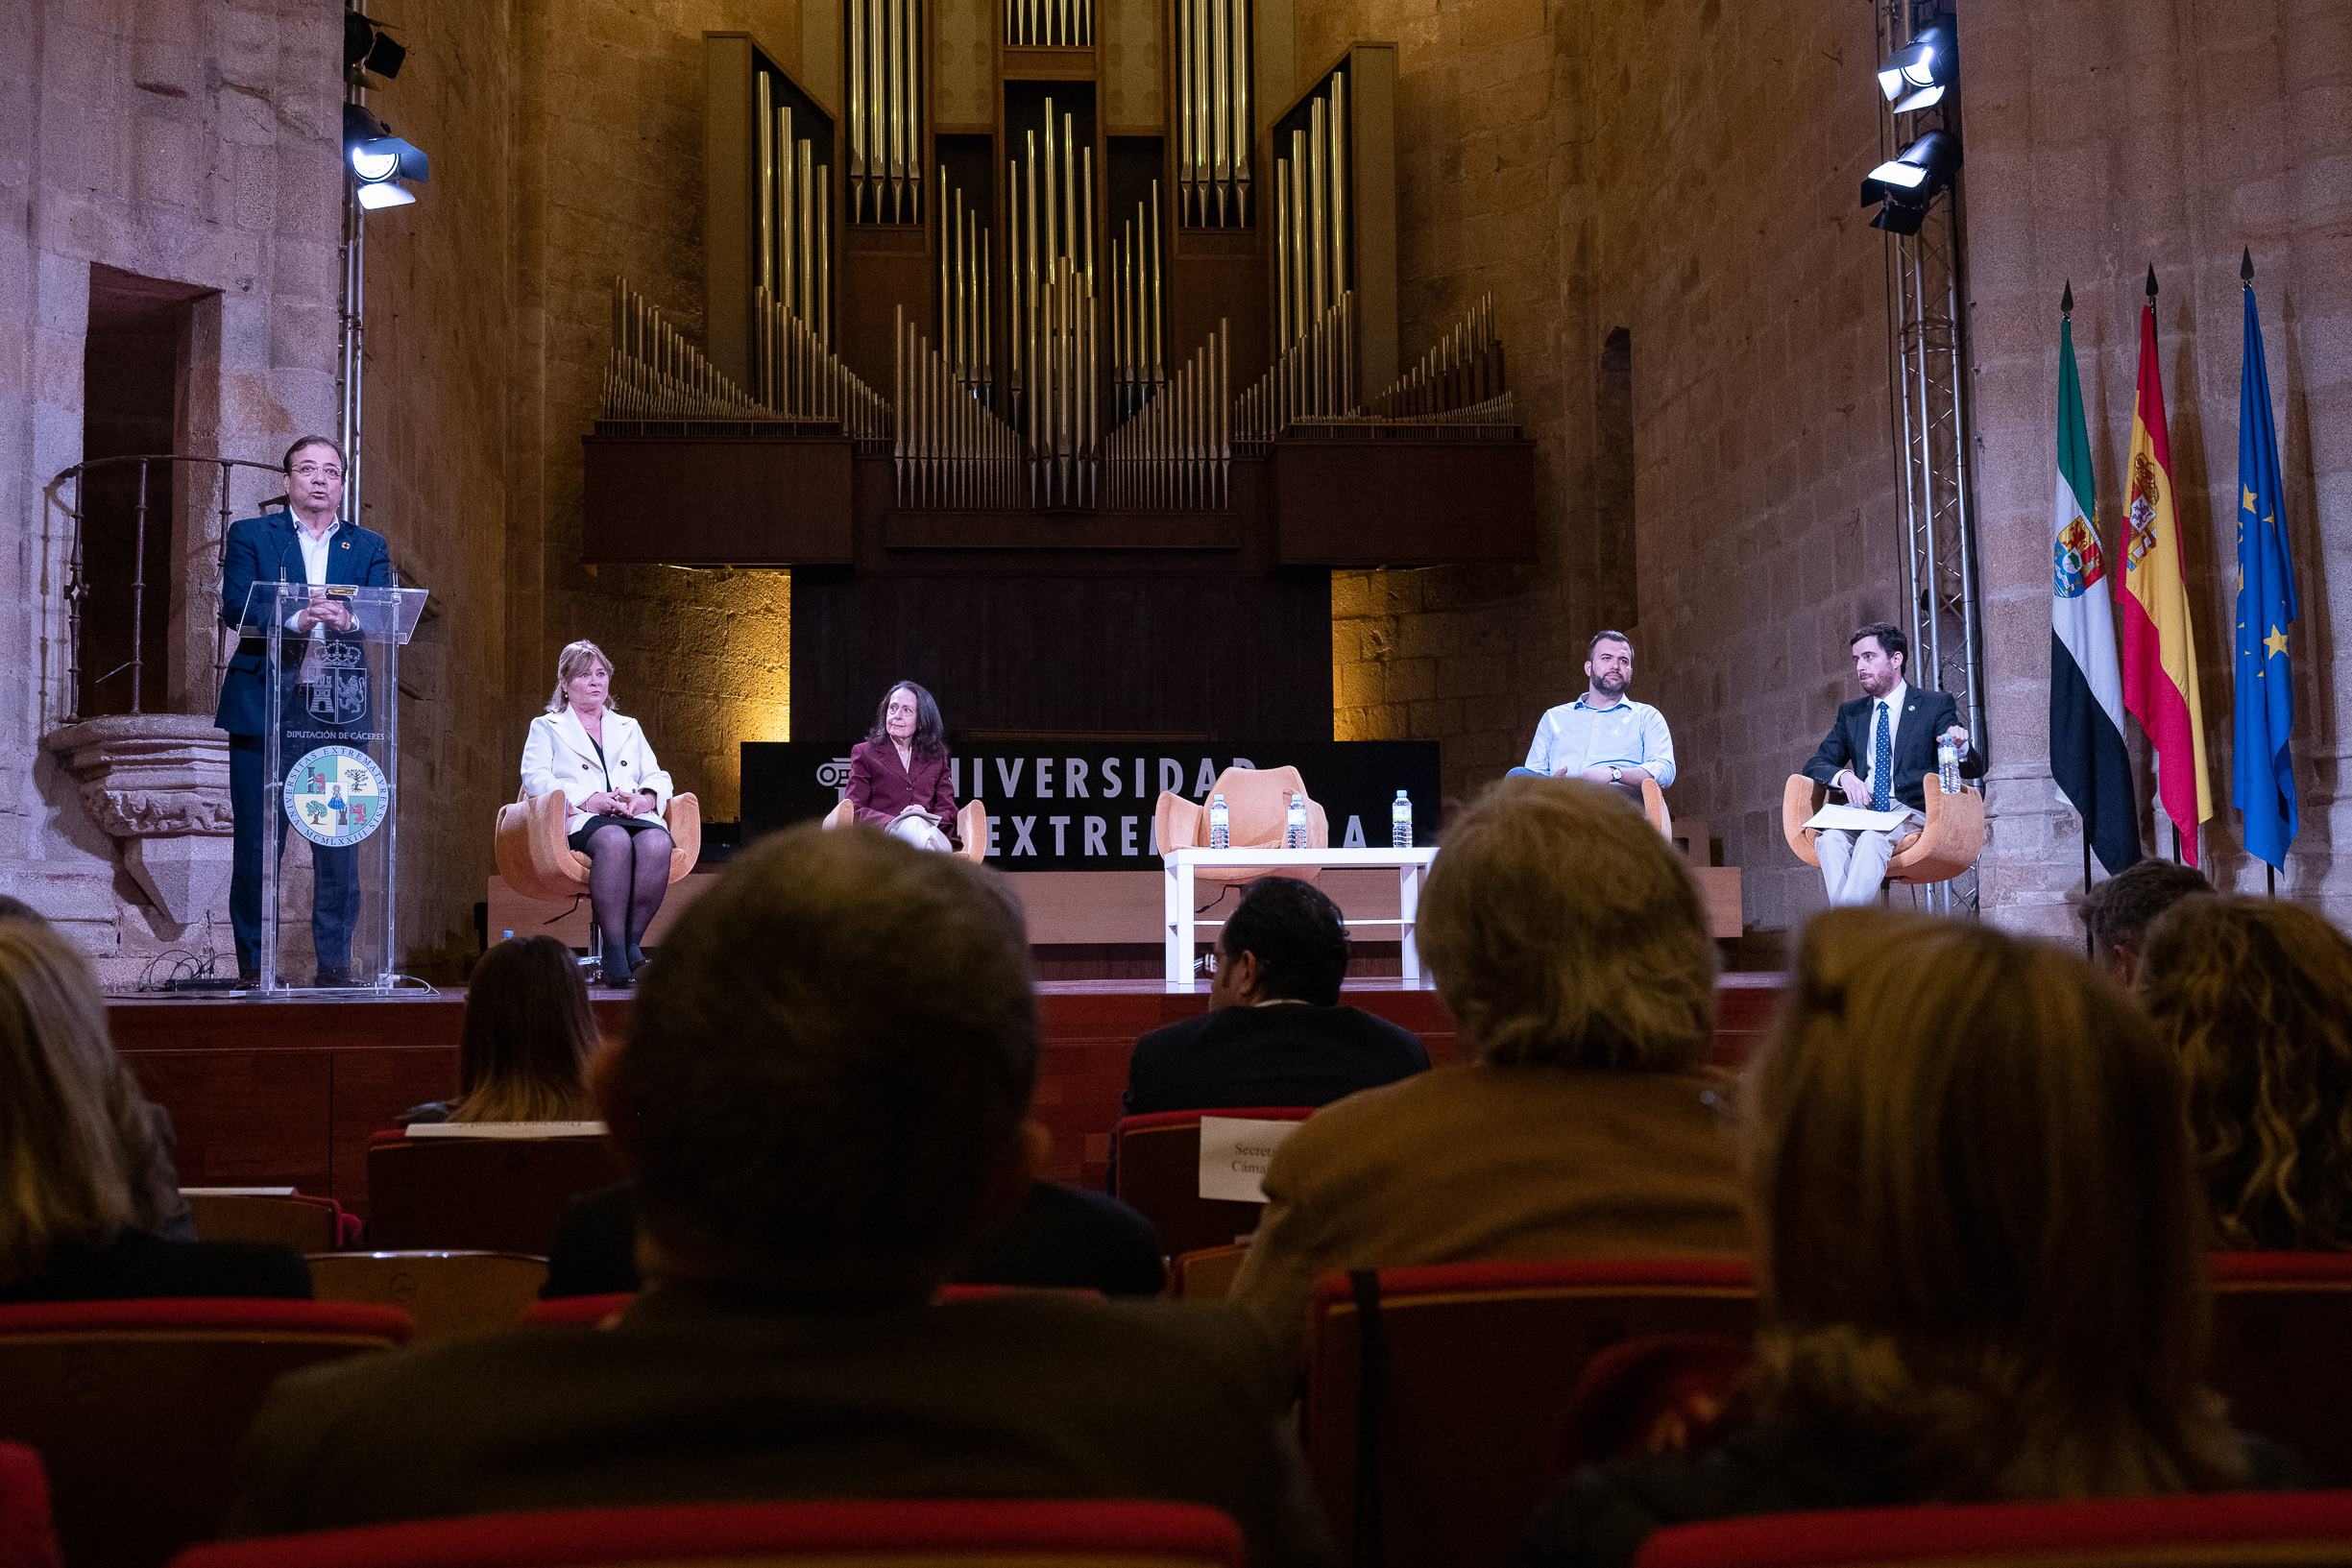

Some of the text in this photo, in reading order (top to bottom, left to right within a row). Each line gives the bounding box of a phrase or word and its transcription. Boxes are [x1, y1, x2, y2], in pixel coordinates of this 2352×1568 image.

[286, 730, 336, 739] DIPUTACIÓN
[350, 731, 384, 740] CÁCERES
[285, 747, 387, 830] VNIVERSITAS EXTREMATVRENSIS
[949, 757, 1256, 798] IVERSIDA
[303, 830, 368, 846] MCMLXXIII
